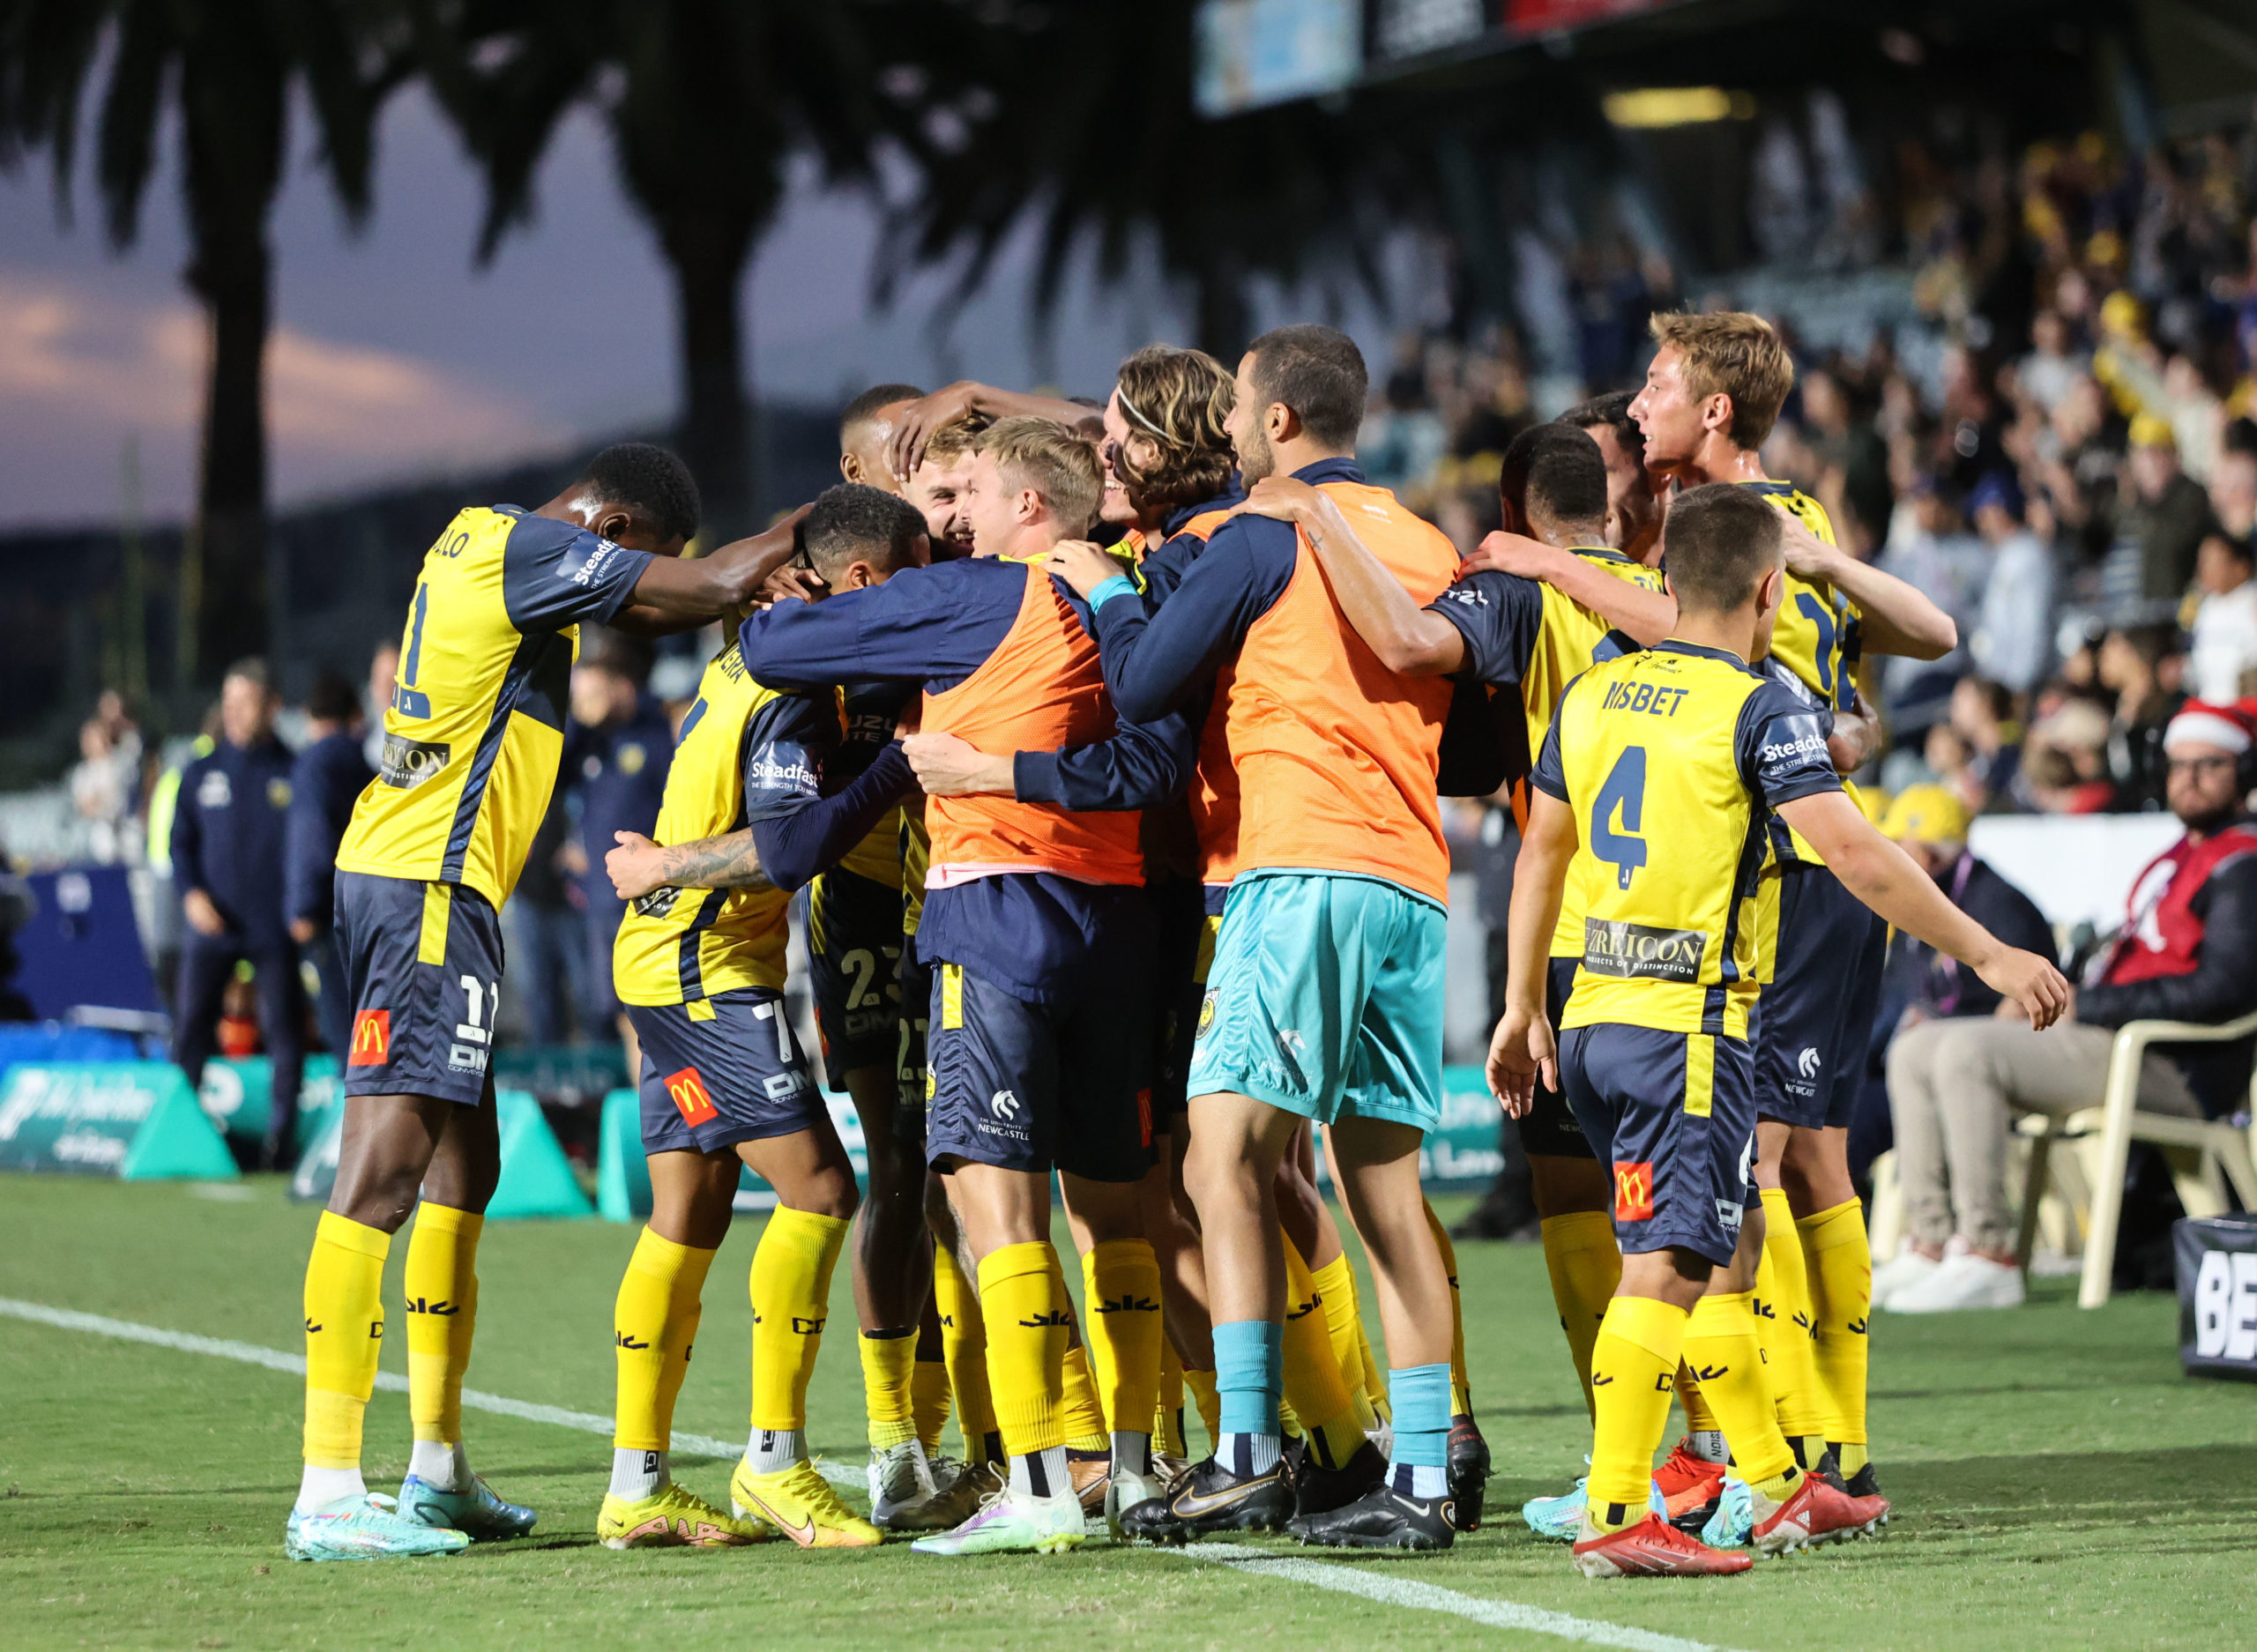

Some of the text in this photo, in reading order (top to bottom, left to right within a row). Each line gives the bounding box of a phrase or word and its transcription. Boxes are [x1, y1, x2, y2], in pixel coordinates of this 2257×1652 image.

[752, 762, 818, 788] Steadfast
[1590, 745, 1648, 891] 4
[1633, 963, 1694, 975] DISTINCTION
[751, 999, 793, 1064] 7
[978, 1123, 1031, 1141] NEWCASTLE
